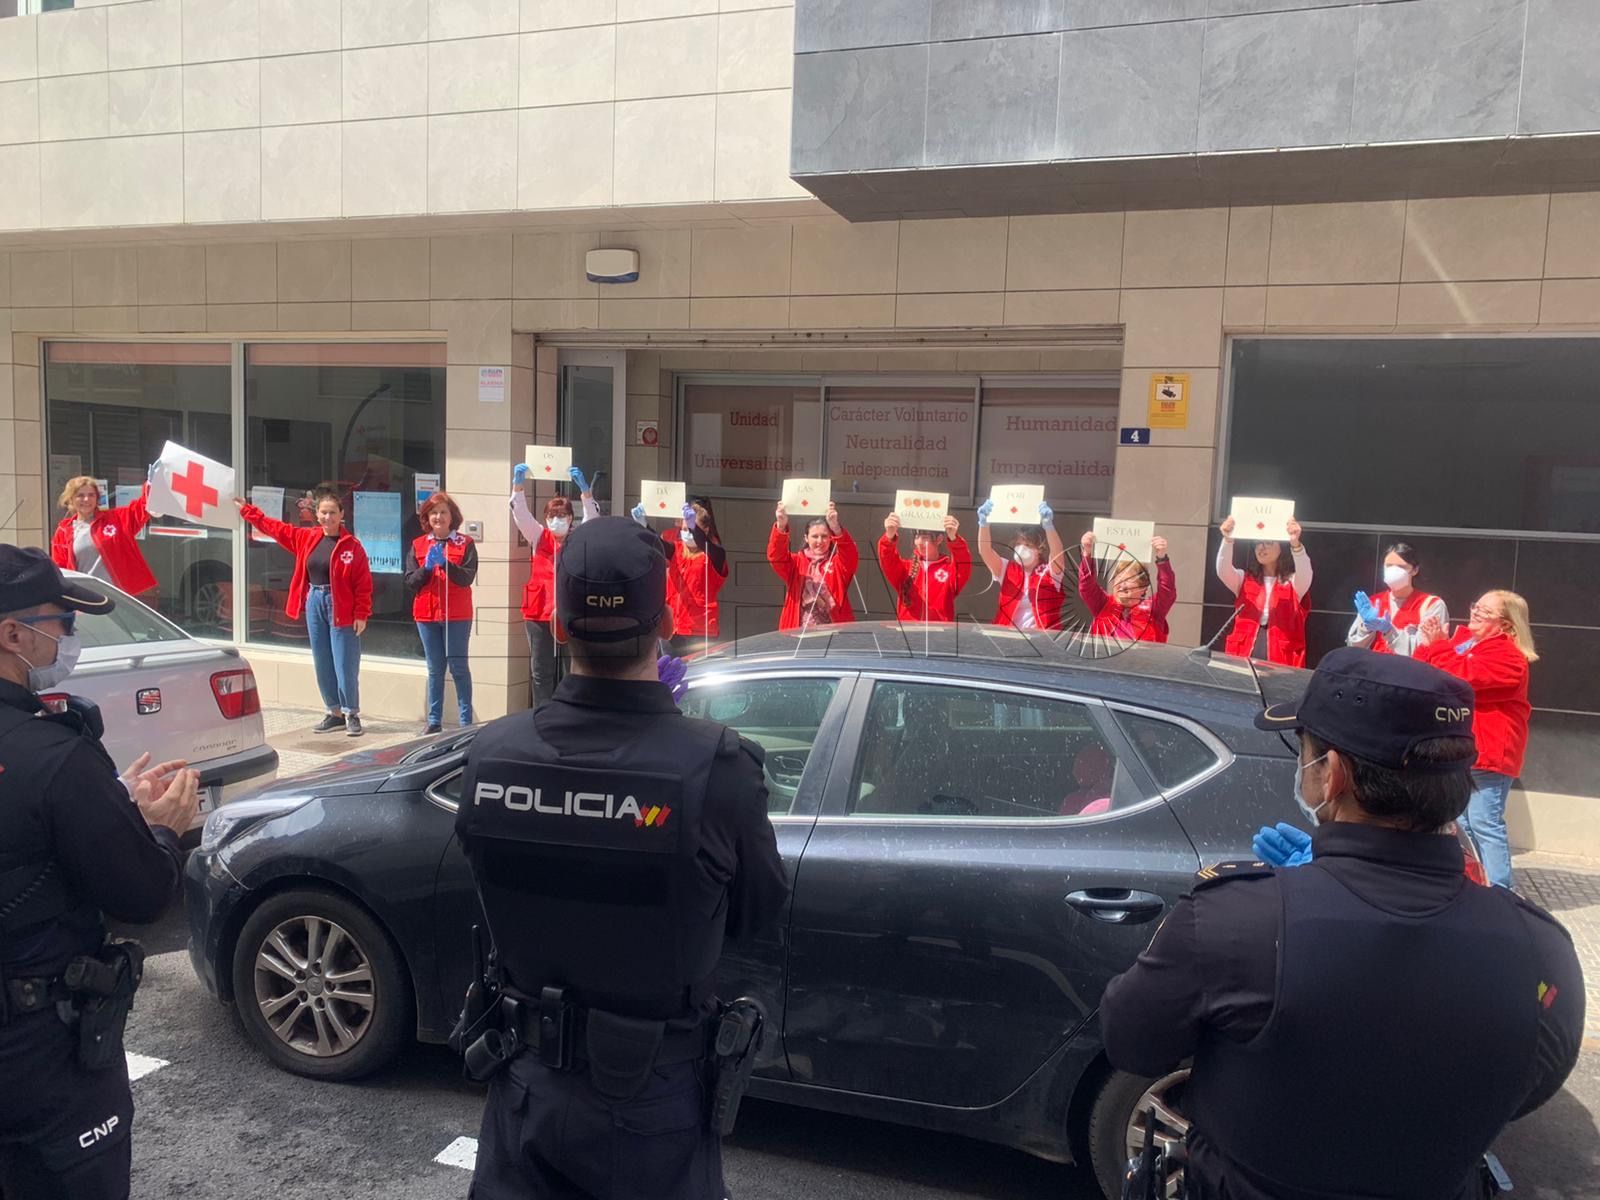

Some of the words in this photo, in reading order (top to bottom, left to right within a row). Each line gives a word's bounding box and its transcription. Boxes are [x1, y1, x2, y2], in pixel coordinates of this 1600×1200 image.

[730, 411, 778, 427] Unidad
[830, 405, 891, 421] Carácter
[894, 406, 968, 422] Voluntario
[1006, 415, 1117, 432] Humanidad
[846, 434, 948, 450] Neutralidad
[1130, 430, 1140, 443] 4
[694, 453, 805, 472] Universalidad
[842, 460, 949, 480] Independencia
[989, 458, 1115, 478] Imparcialida
[1106, 526, 1142, 537] ESTAR
[586, 595, 624, 608] CNP
[1435, 706, 1470, 723] CNP
[474, 782, 644, 820] POLICIA
[79, 1115, 119, 1148] CNP
